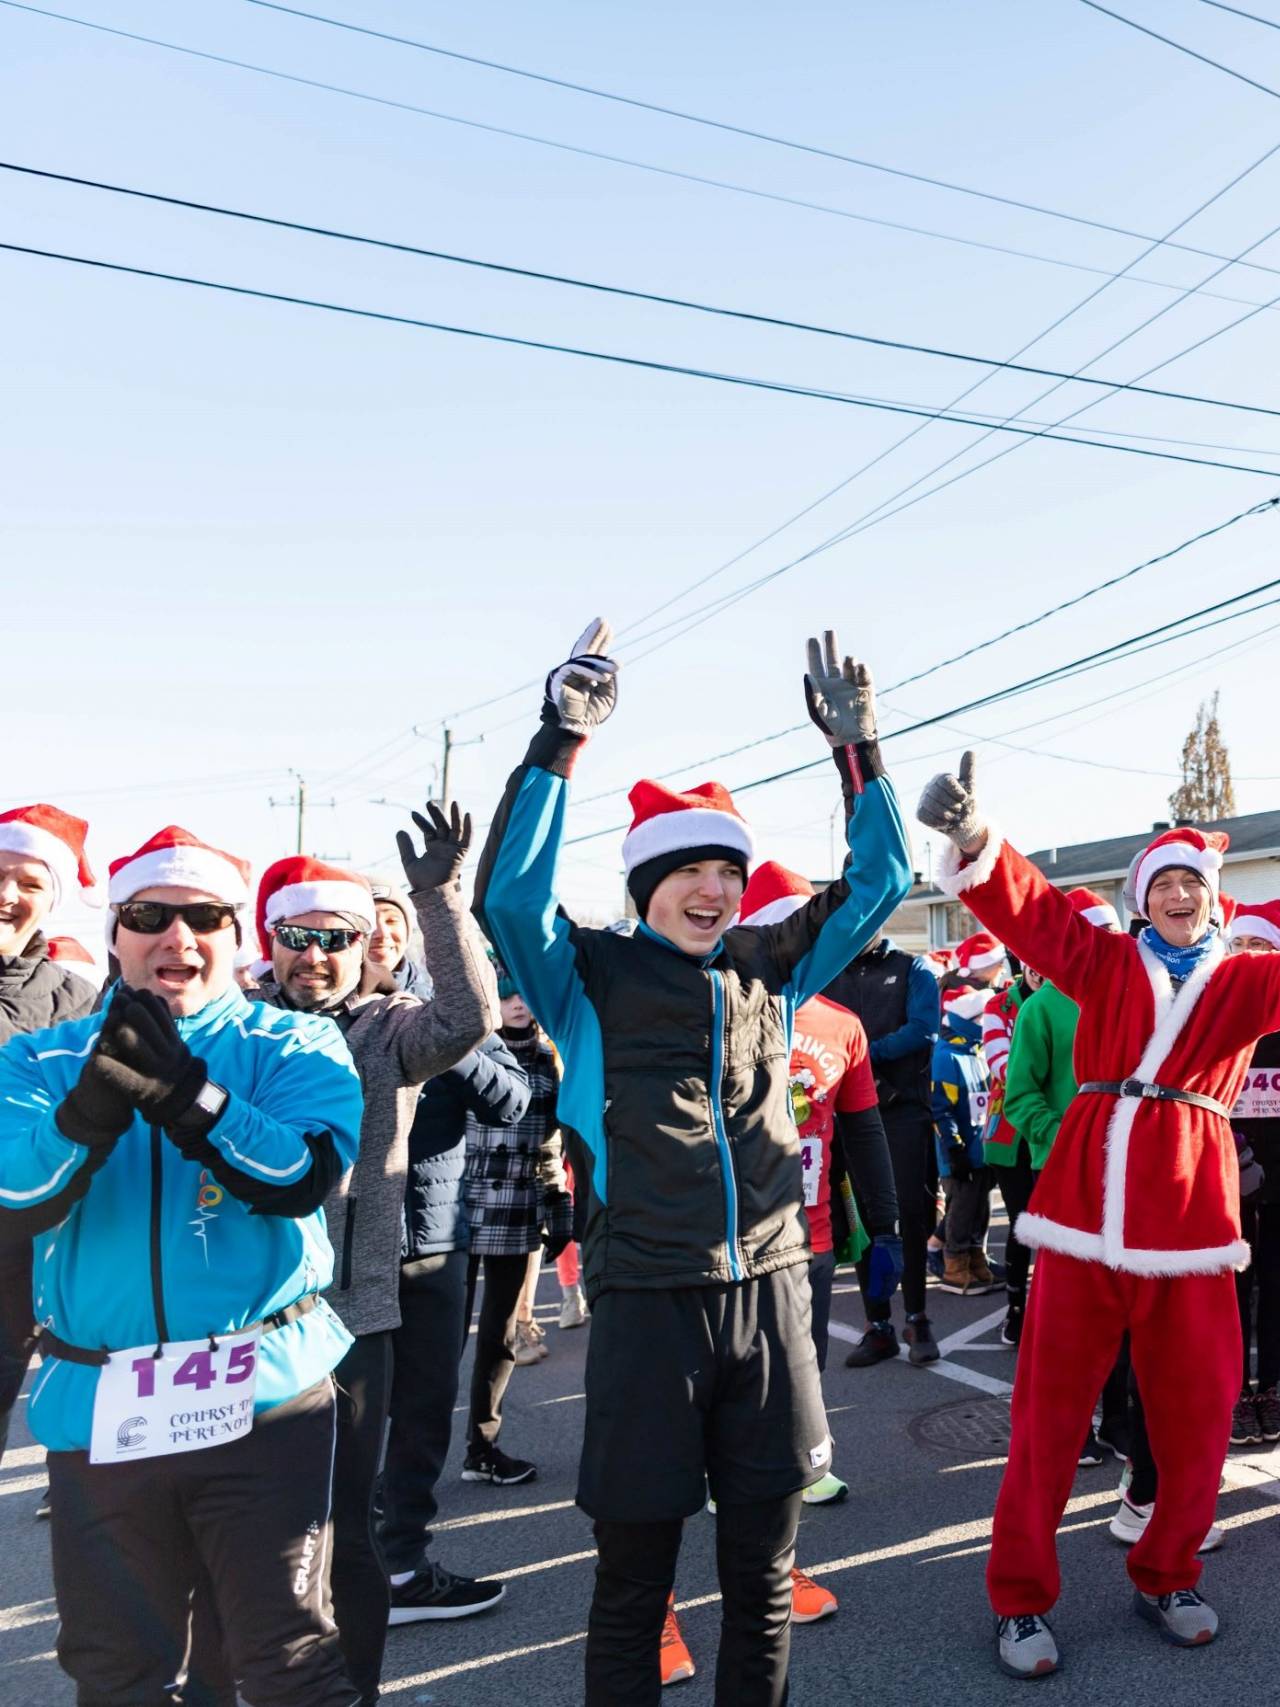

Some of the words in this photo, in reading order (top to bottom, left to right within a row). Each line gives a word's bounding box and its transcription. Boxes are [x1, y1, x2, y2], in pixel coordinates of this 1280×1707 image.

[792, 1031, 839, 1082] RINCH
[132, 1341, 255, 1398] 145
[170, 1403, 235, 1428] COURSE
[293, 1534, 316, 1595] CRAFT
